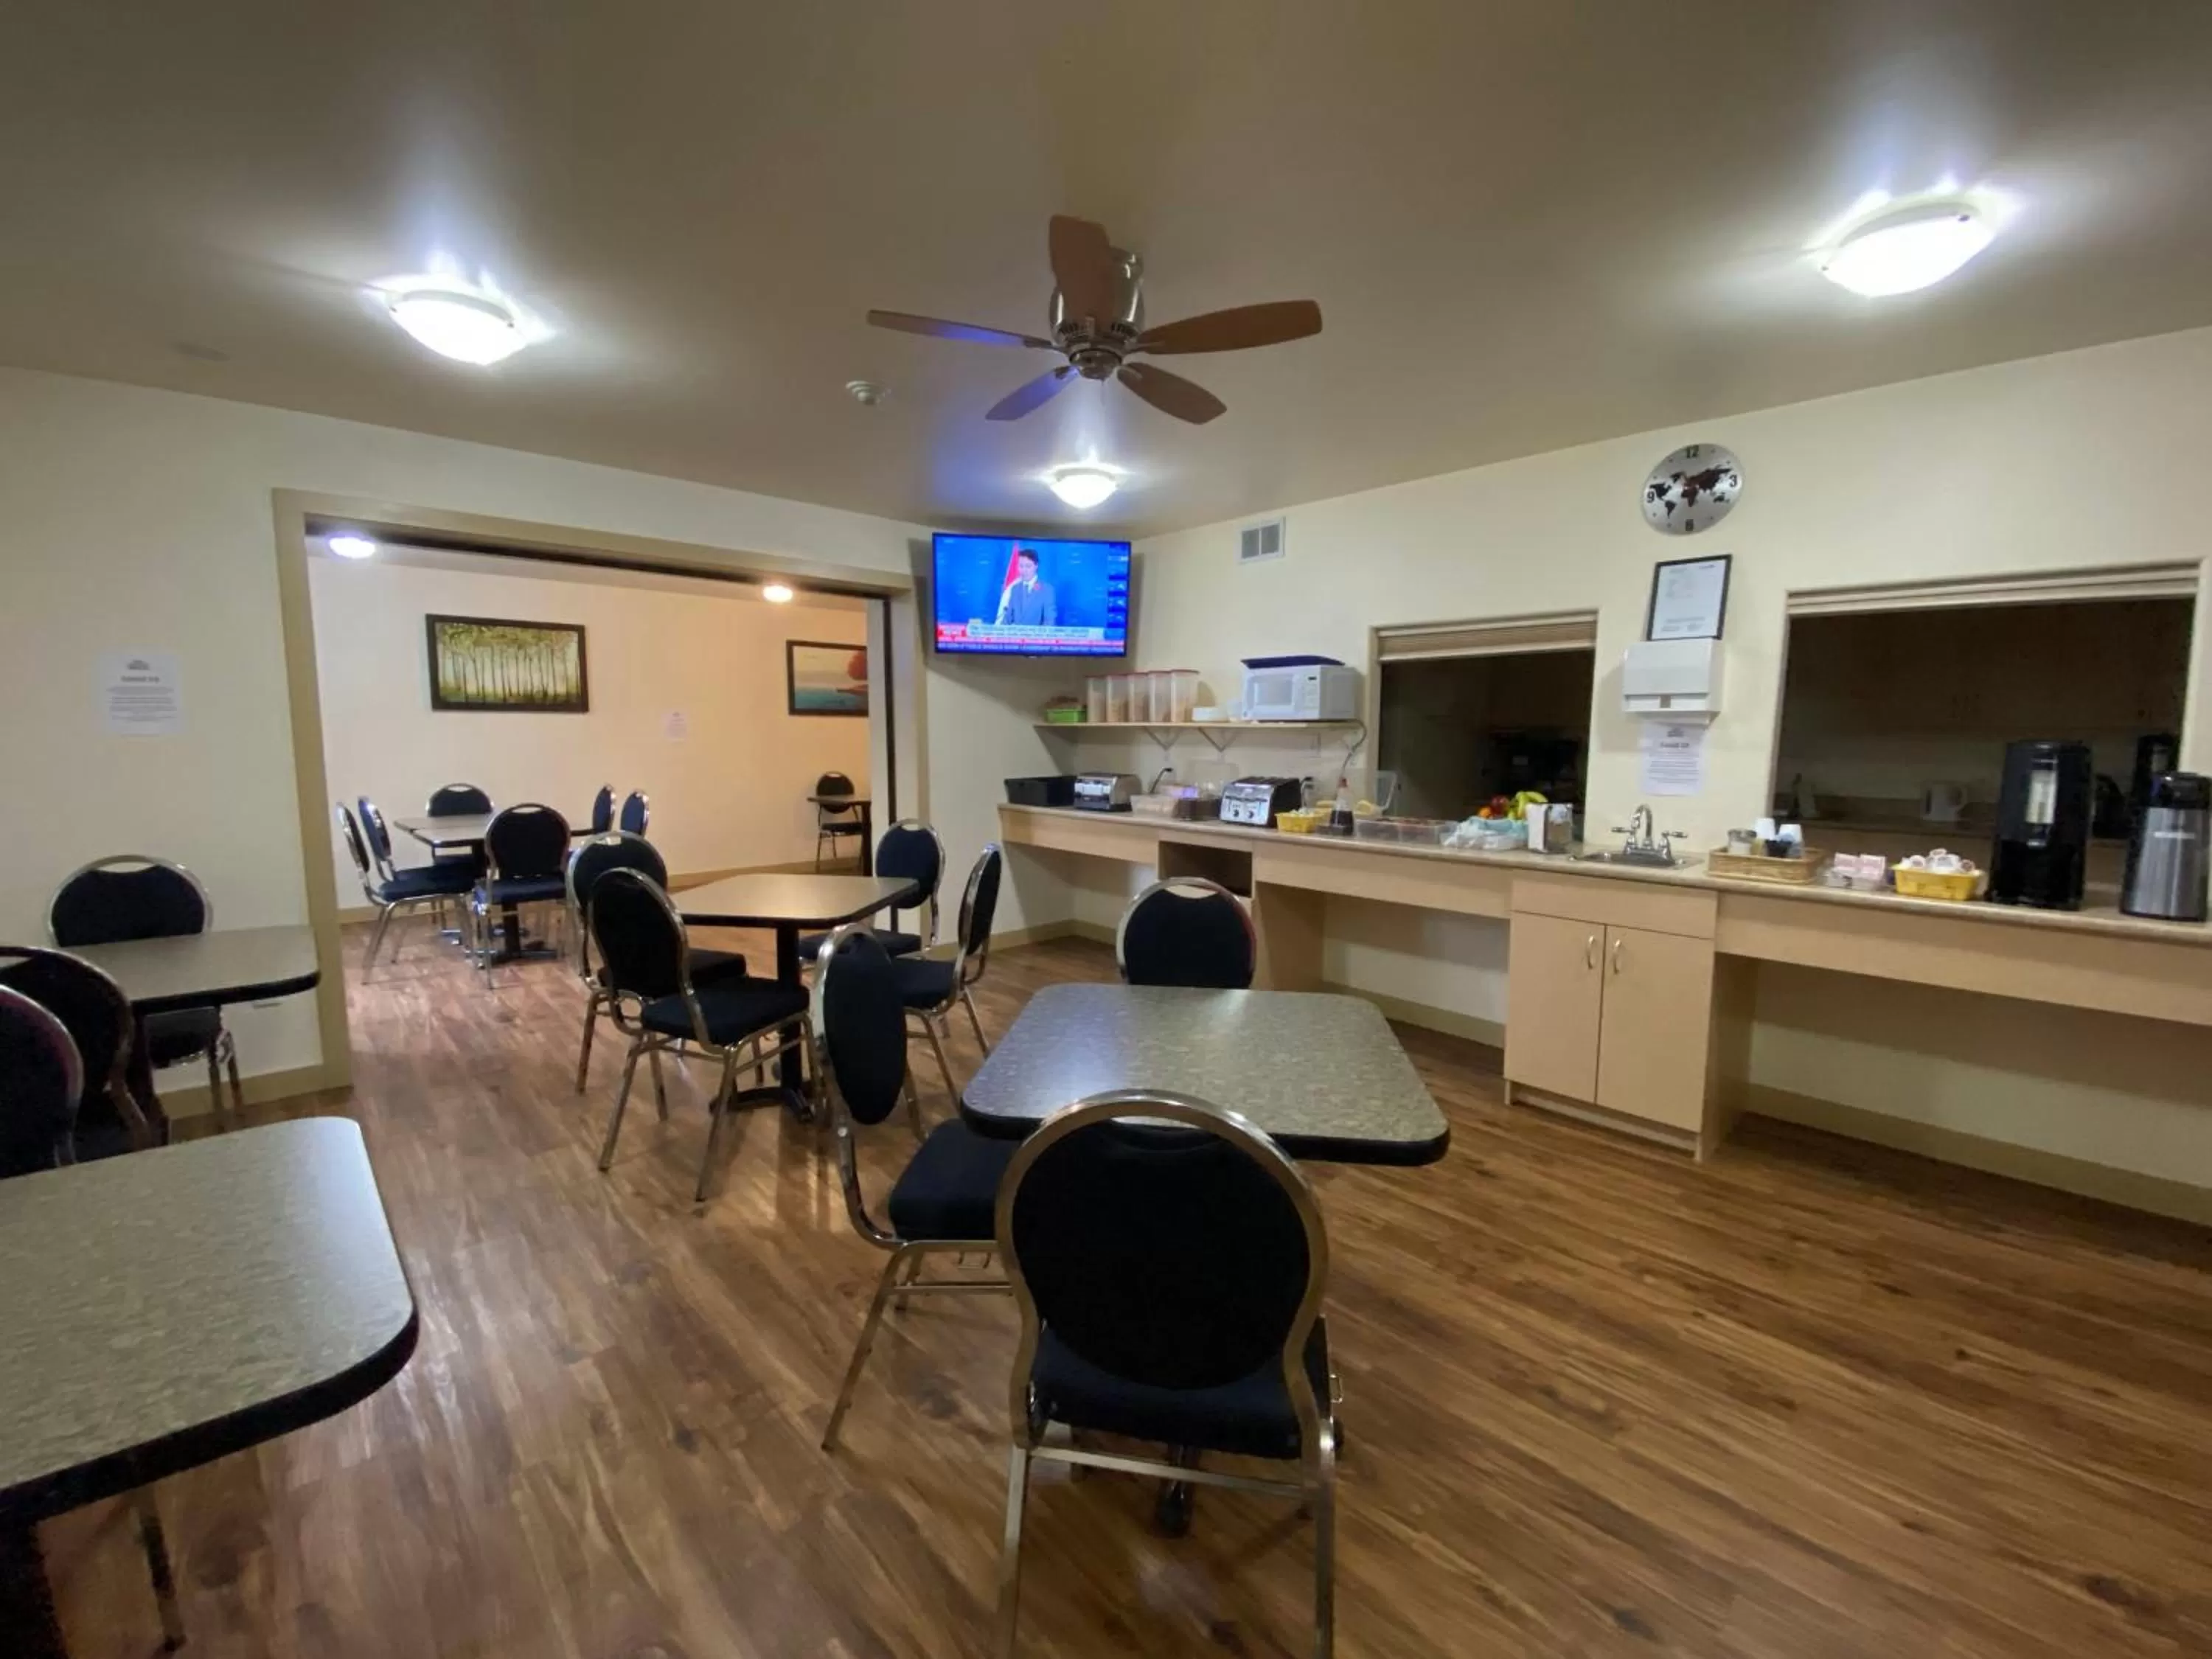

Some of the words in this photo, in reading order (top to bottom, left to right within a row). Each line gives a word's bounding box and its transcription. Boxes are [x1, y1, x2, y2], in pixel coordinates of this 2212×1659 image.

[1686, 445, 1699, 459] 12
[1729, 474, 1738, 487] 3
[1646, 490, 1655, 503] 9
